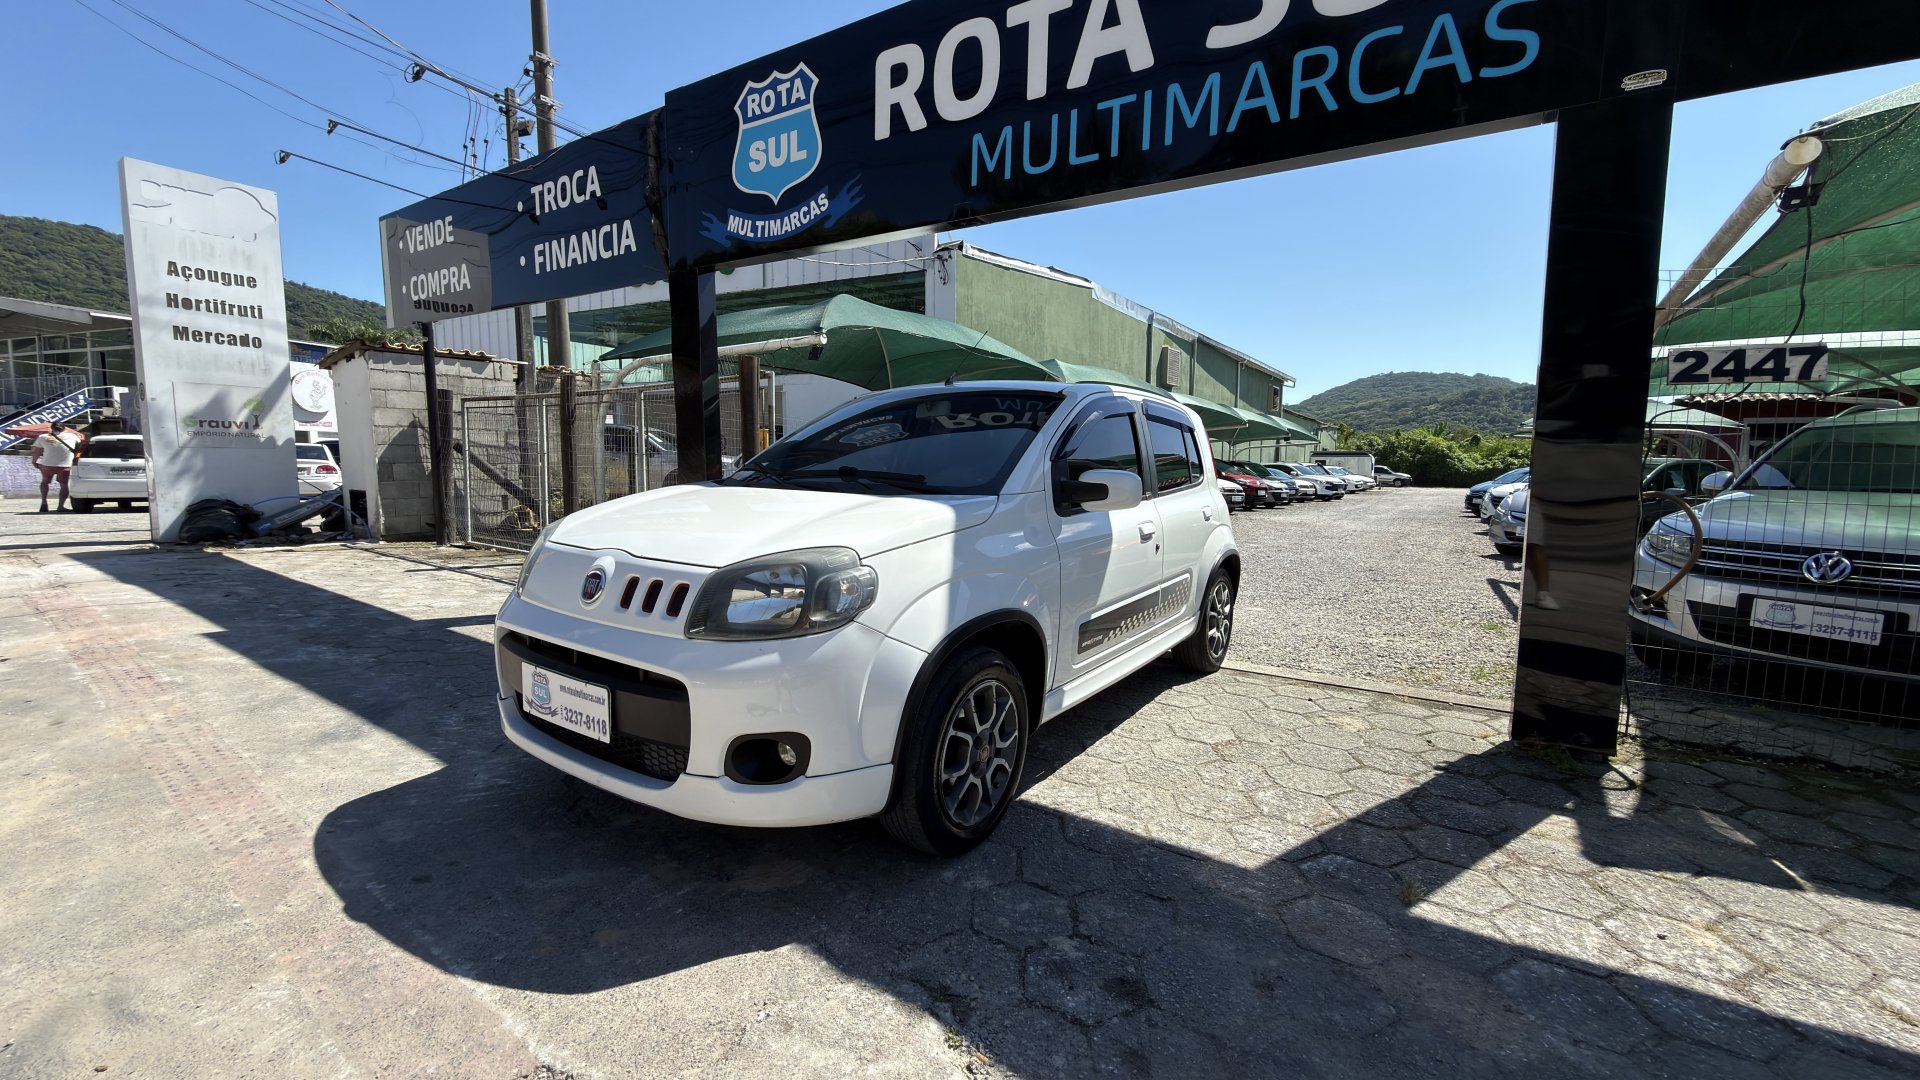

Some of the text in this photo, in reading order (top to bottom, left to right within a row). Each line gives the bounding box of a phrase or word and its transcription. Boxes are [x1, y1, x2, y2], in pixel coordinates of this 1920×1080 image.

[875, 0, 1155, 141] ROTA
[747, 78, 806, 117] ROTA
[971, 0, 1540, 187] MULTIMARCAS
[748, 130, 807, 173] SUL
[531, 165, 601, 216] TROCA
[406, 215, 454, 254] VENDE
[727, 193, 829, 238] MULTIMARCAS
[534, 219, 636, 275] FINANCIA
[167, 260, 257, 289] Açougue
[410, 263, 471, 301] COMPRA
[166, 292, 263, 320] Hortifruti
[172, 325, 262, 349] Mercado
[1670, 345, 1828, 383] 2447
[228, 431, 266, 439] NATURAL
[534, 686, 547, 699] SUL
[563, 706, 607, 735] 3237-8118
